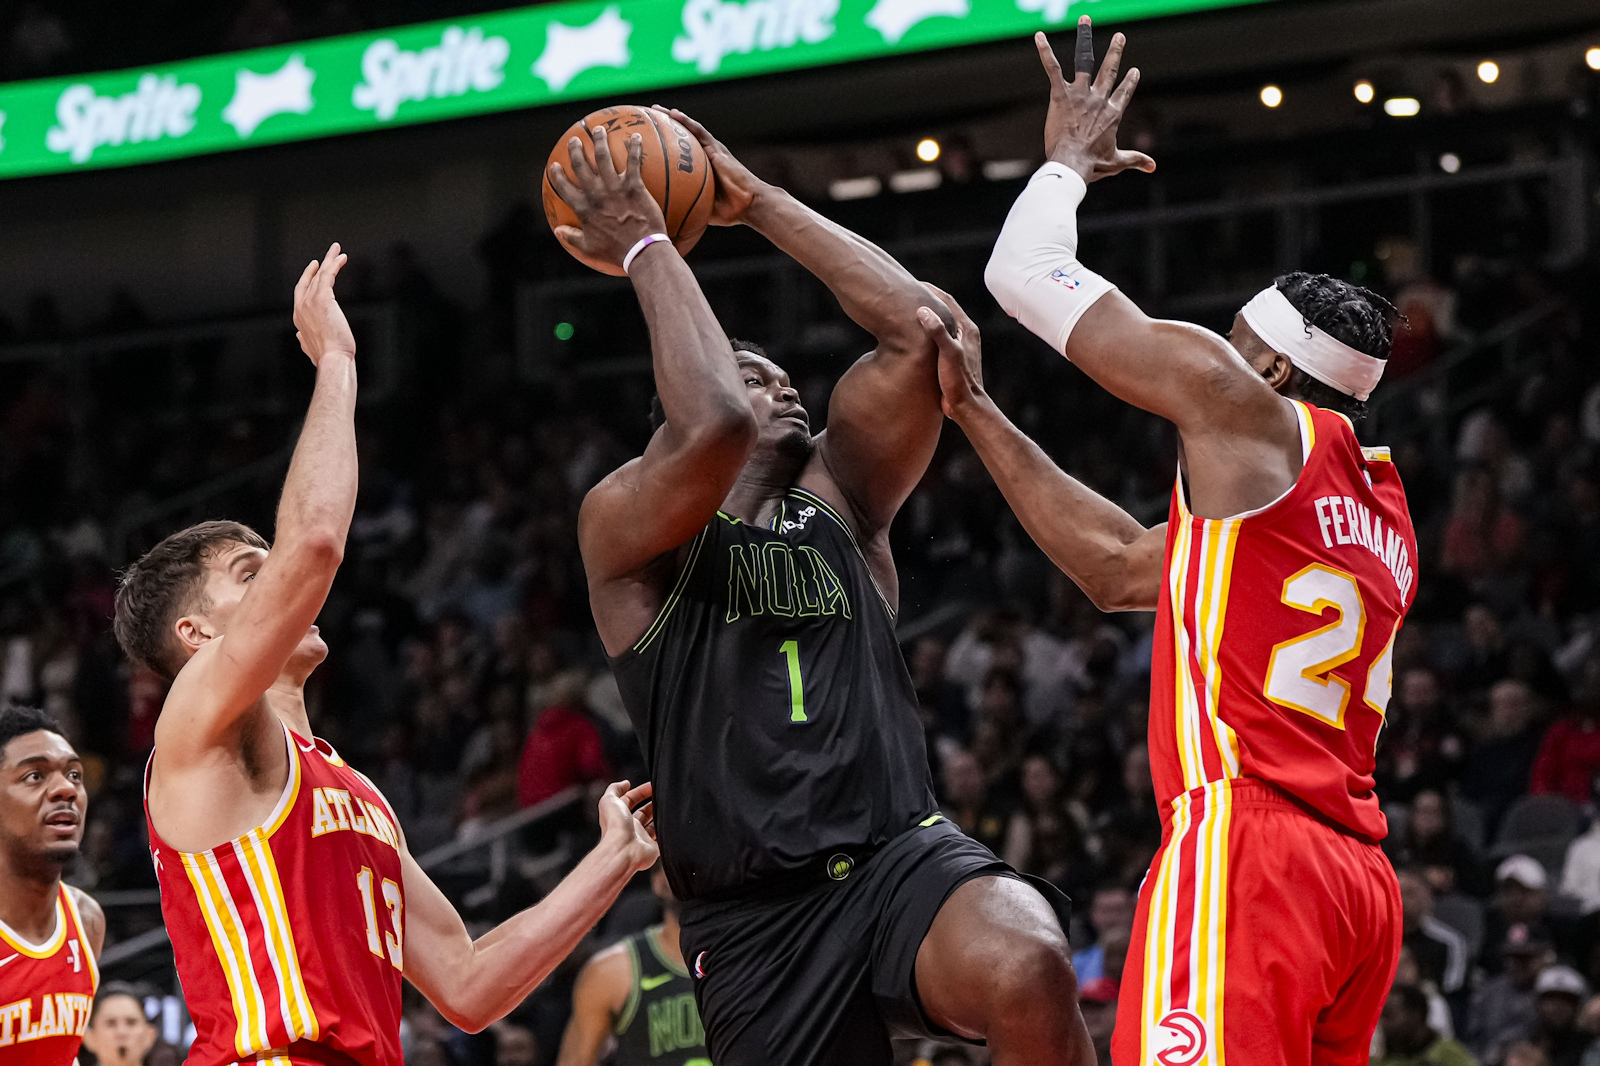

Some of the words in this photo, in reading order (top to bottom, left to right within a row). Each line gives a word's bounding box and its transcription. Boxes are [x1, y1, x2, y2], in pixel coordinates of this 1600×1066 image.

[352, 27, 510, 120] Sprite
[671, 0, 840, 74] Sprite
[47, 75, 202, 163] Sprite
[726, 541, 852, 624] NOLA
[1314, 495, 1414, 607] FERNANDO
[779, 640, 808, 722] 1
[311, 787, 399, 850] ATLAN
[357, 865, 403, 972] 13
[0, 992, 94, 1048] TLANT
[648, 992, 706, 1057] NO
